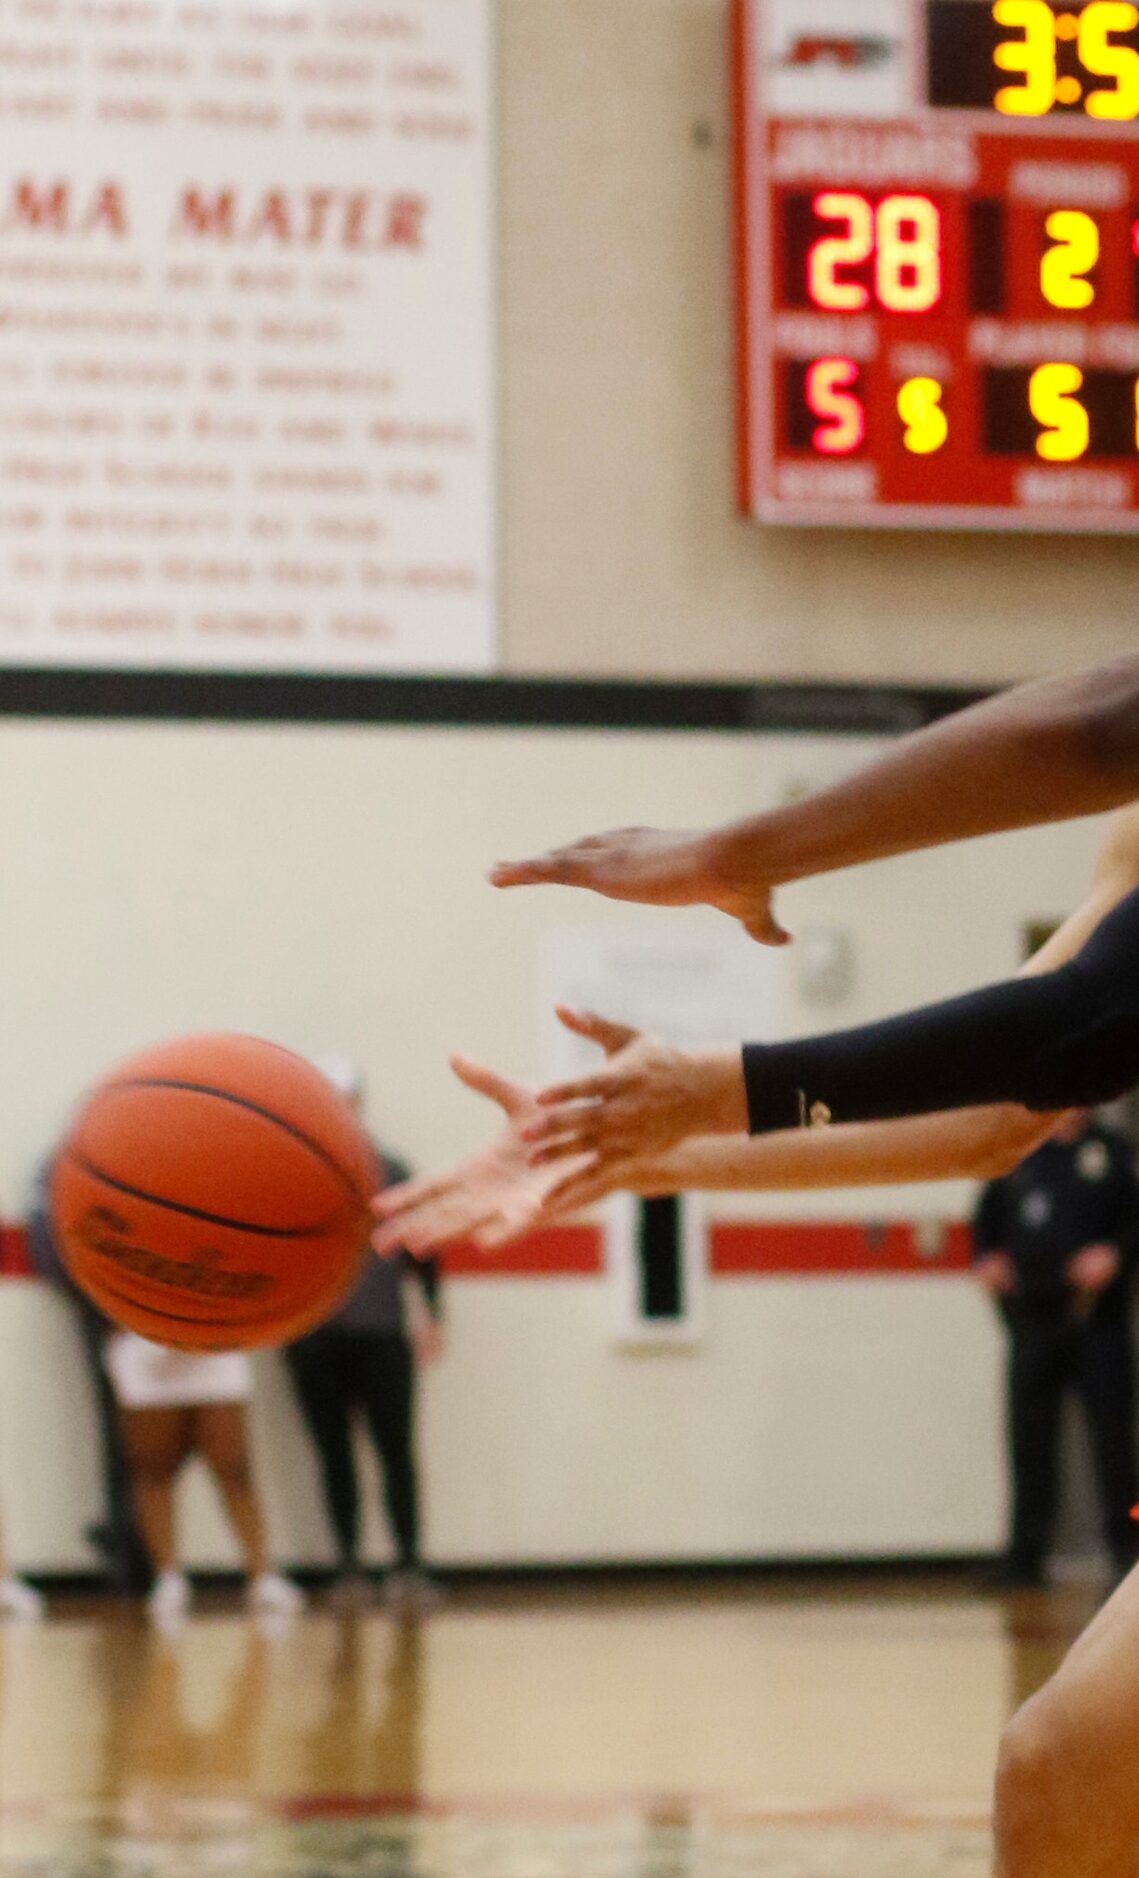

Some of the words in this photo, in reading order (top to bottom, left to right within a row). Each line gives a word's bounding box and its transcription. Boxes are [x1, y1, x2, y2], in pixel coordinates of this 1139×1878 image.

[172, 180, 430, 256] MATER
[806, 190, 943, 313] 28
[1039, 210, 1100, 309] 2
[806, 356, 866, 455] 5
